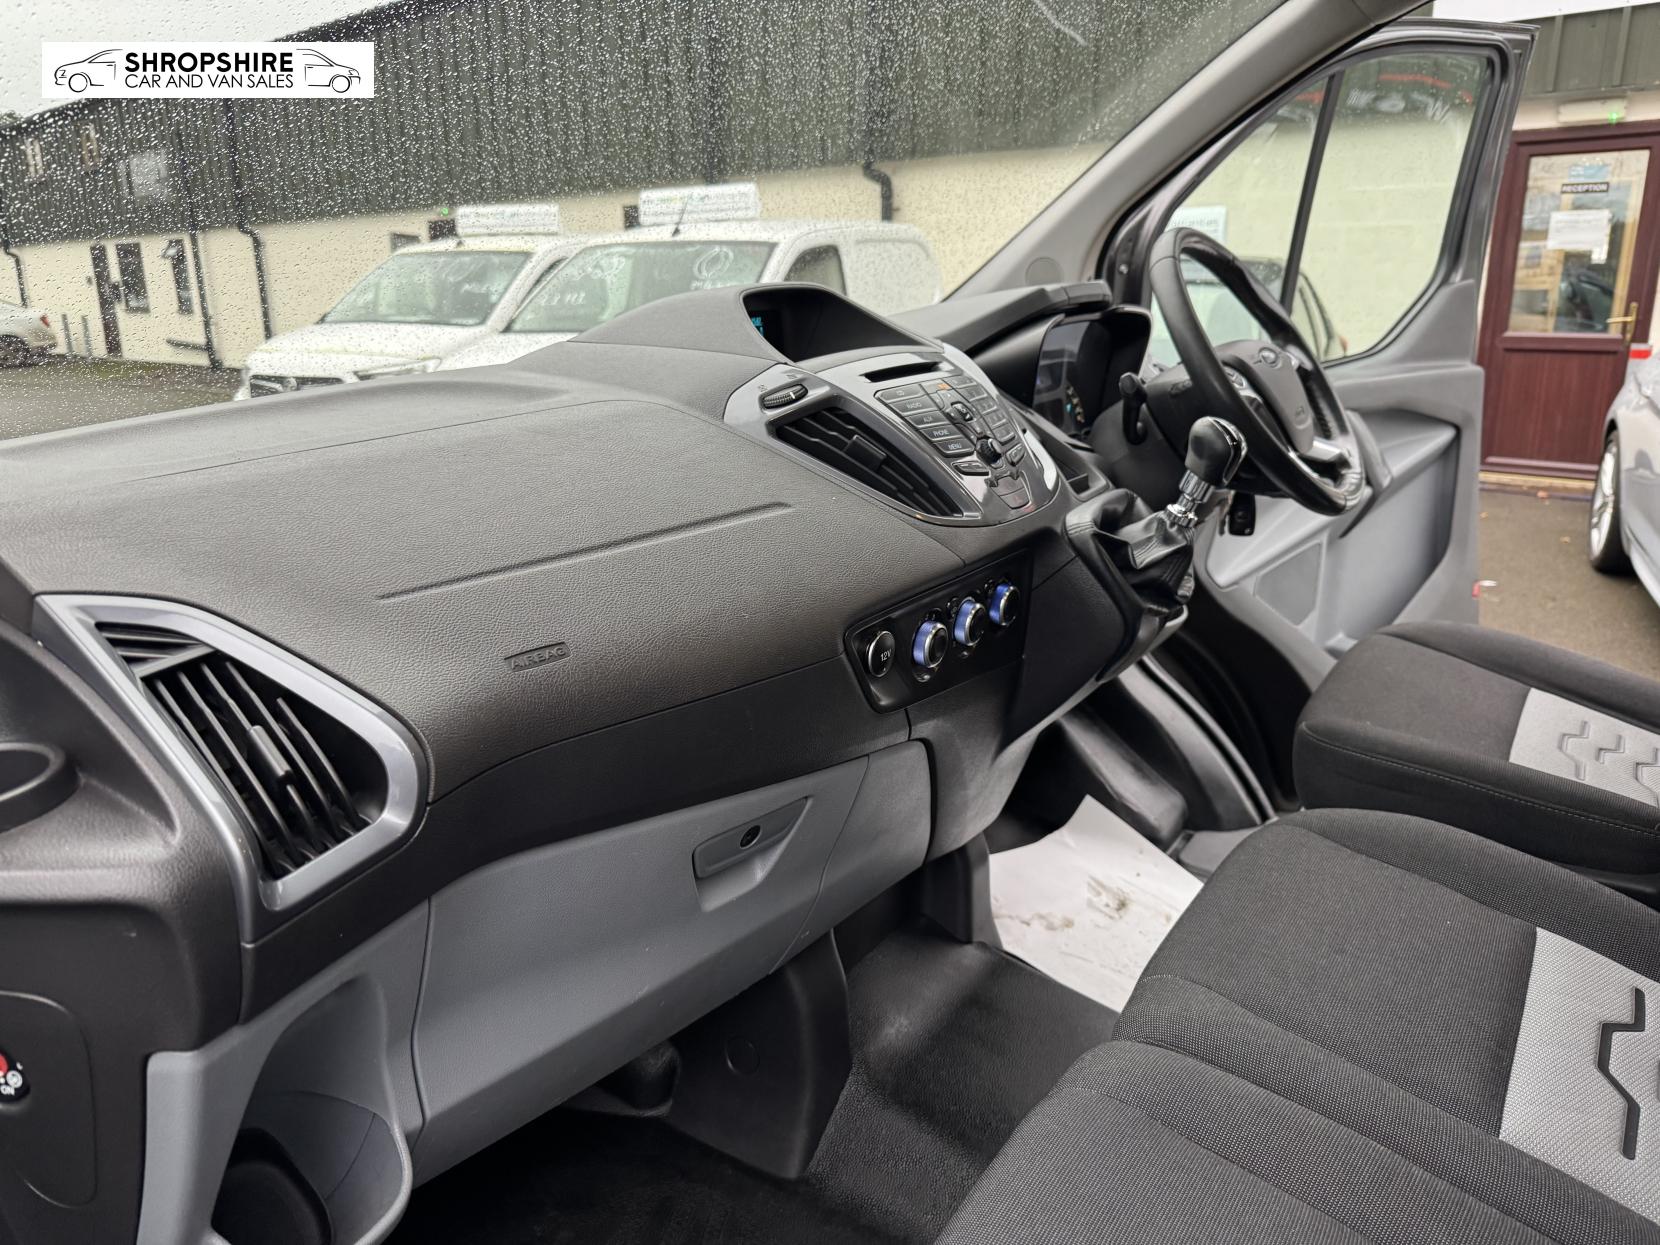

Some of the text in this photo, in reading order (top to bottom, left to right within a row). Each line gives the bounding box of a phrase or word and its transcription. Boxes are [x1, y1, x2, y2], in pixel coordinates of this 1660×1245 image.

[1562, 184, 1608, 193] RECEPTION
[933, 429, 949, 437] PHONE
[948, 442, 962, 450] MENU
[511, 647, 566, 670] AIRBAG
[881, 648, 892, 661] 12V
